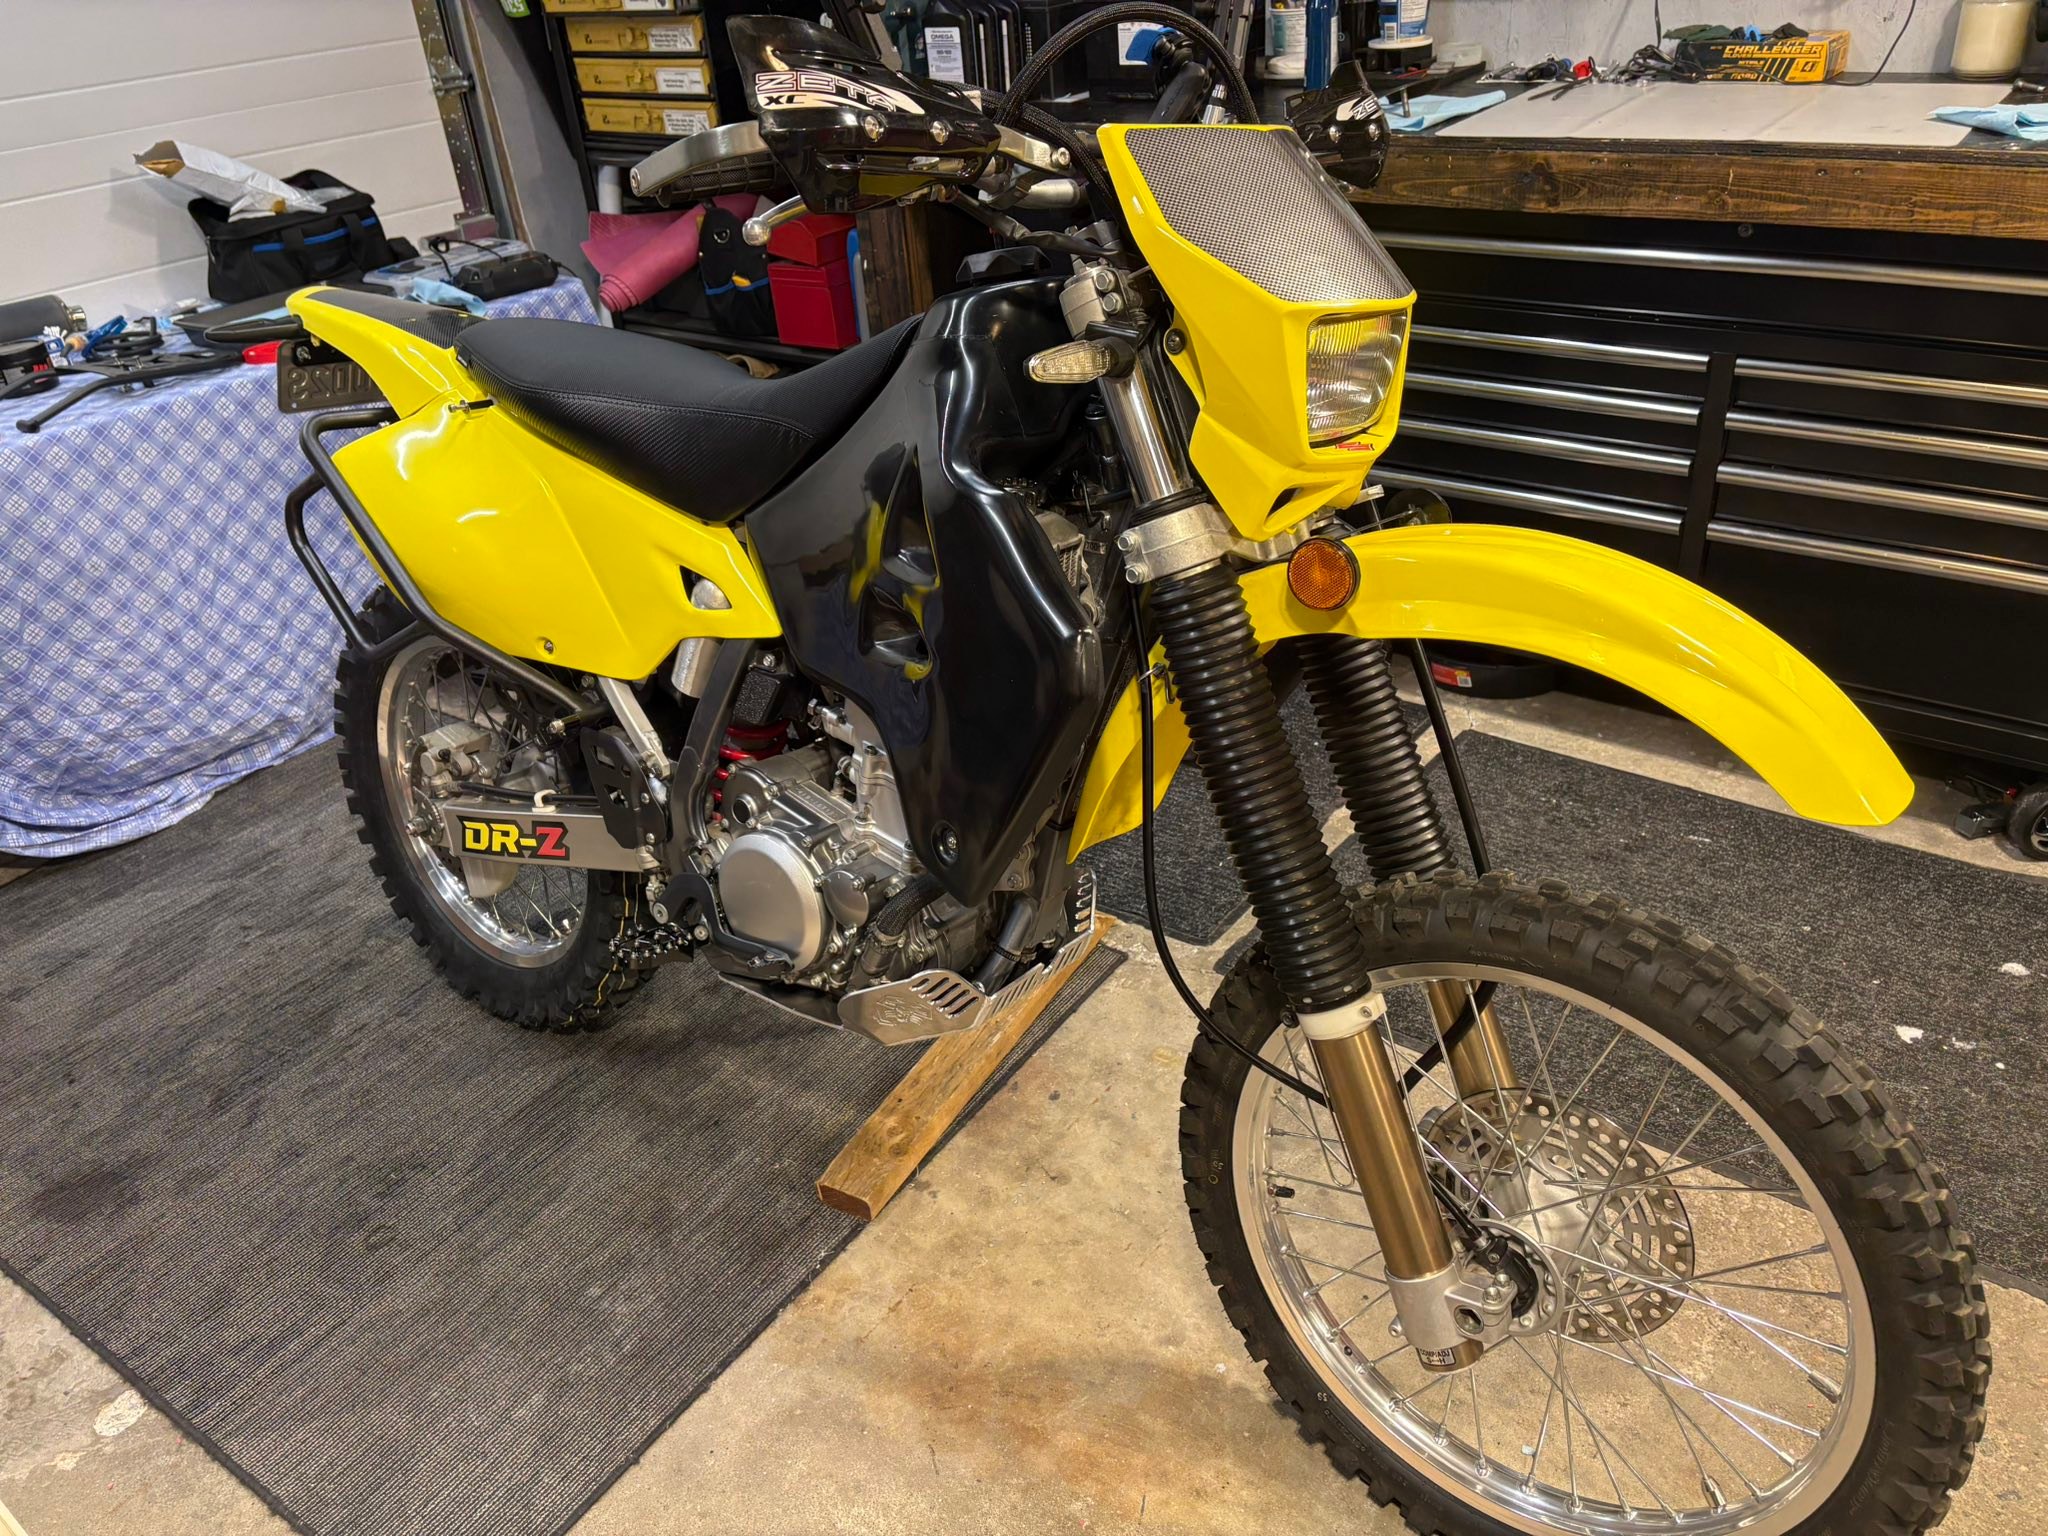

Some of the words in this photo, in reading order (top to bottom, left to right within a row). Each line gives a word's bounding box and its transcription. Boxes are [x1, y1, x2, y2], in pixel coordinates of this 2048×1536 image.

[1724, 45, 1822, 54] CHALLENGER
[755, 71, 897, 113] ZETA
[763, 94, 808, 106] XC
[463, 821, 567, 857] DR-Z
